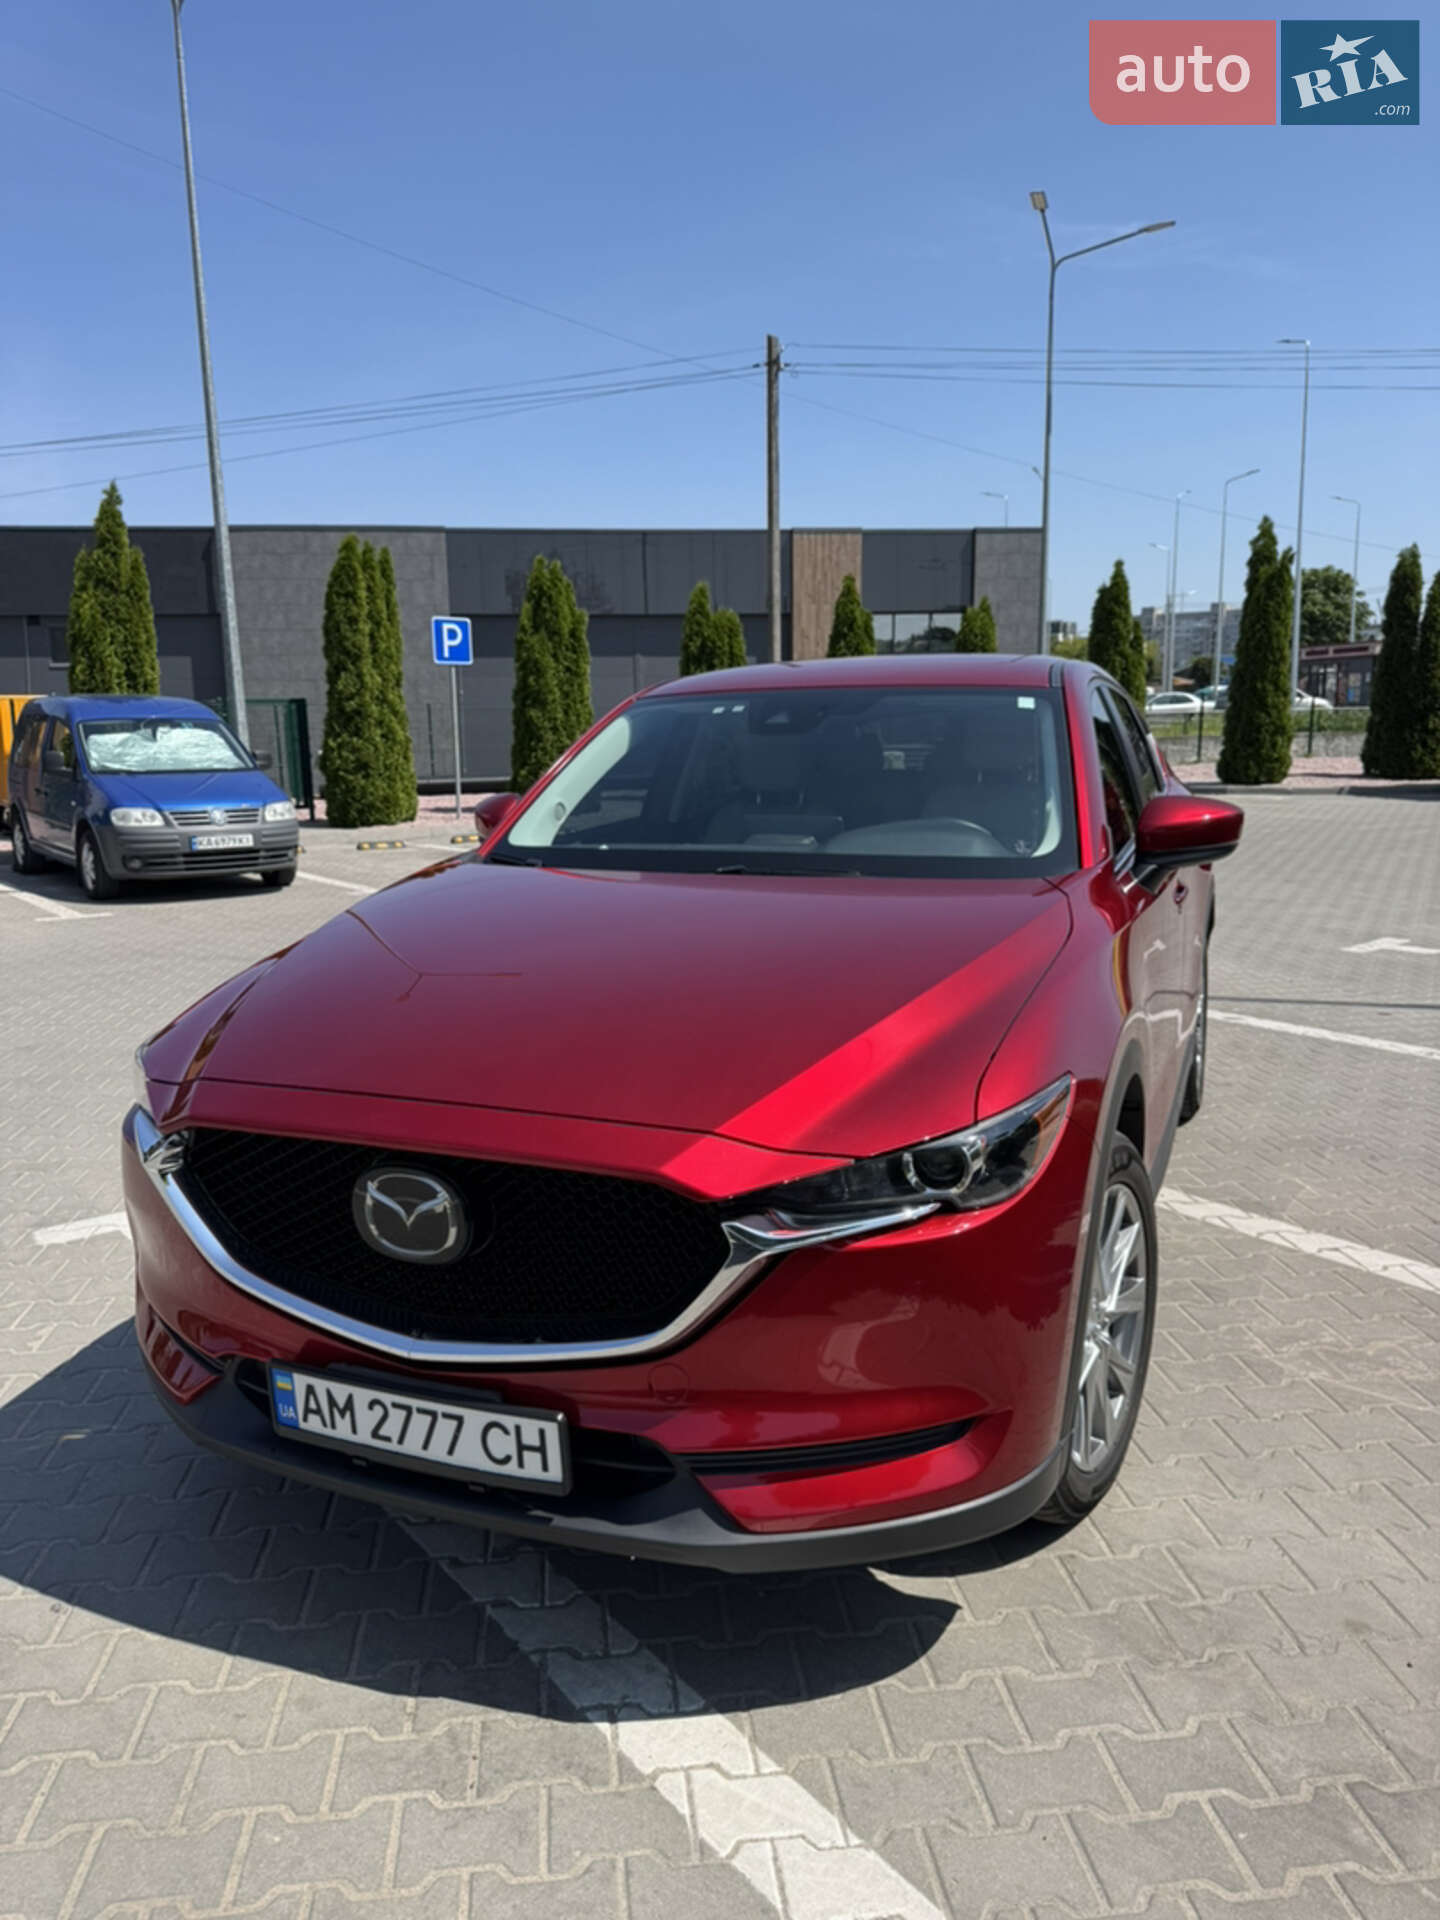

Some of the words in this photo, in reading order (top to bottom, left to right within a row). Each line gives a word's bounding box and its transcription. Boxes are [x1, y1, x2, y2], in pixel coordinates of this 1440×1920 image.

[442, 622, 463, 658] P
[278, 1402, 297, 1420] UA
[302, 1383, 357, 1436] AM
[367, 1398, 464, 1457] 2777
[480, 1420, 549, 1473] CH
